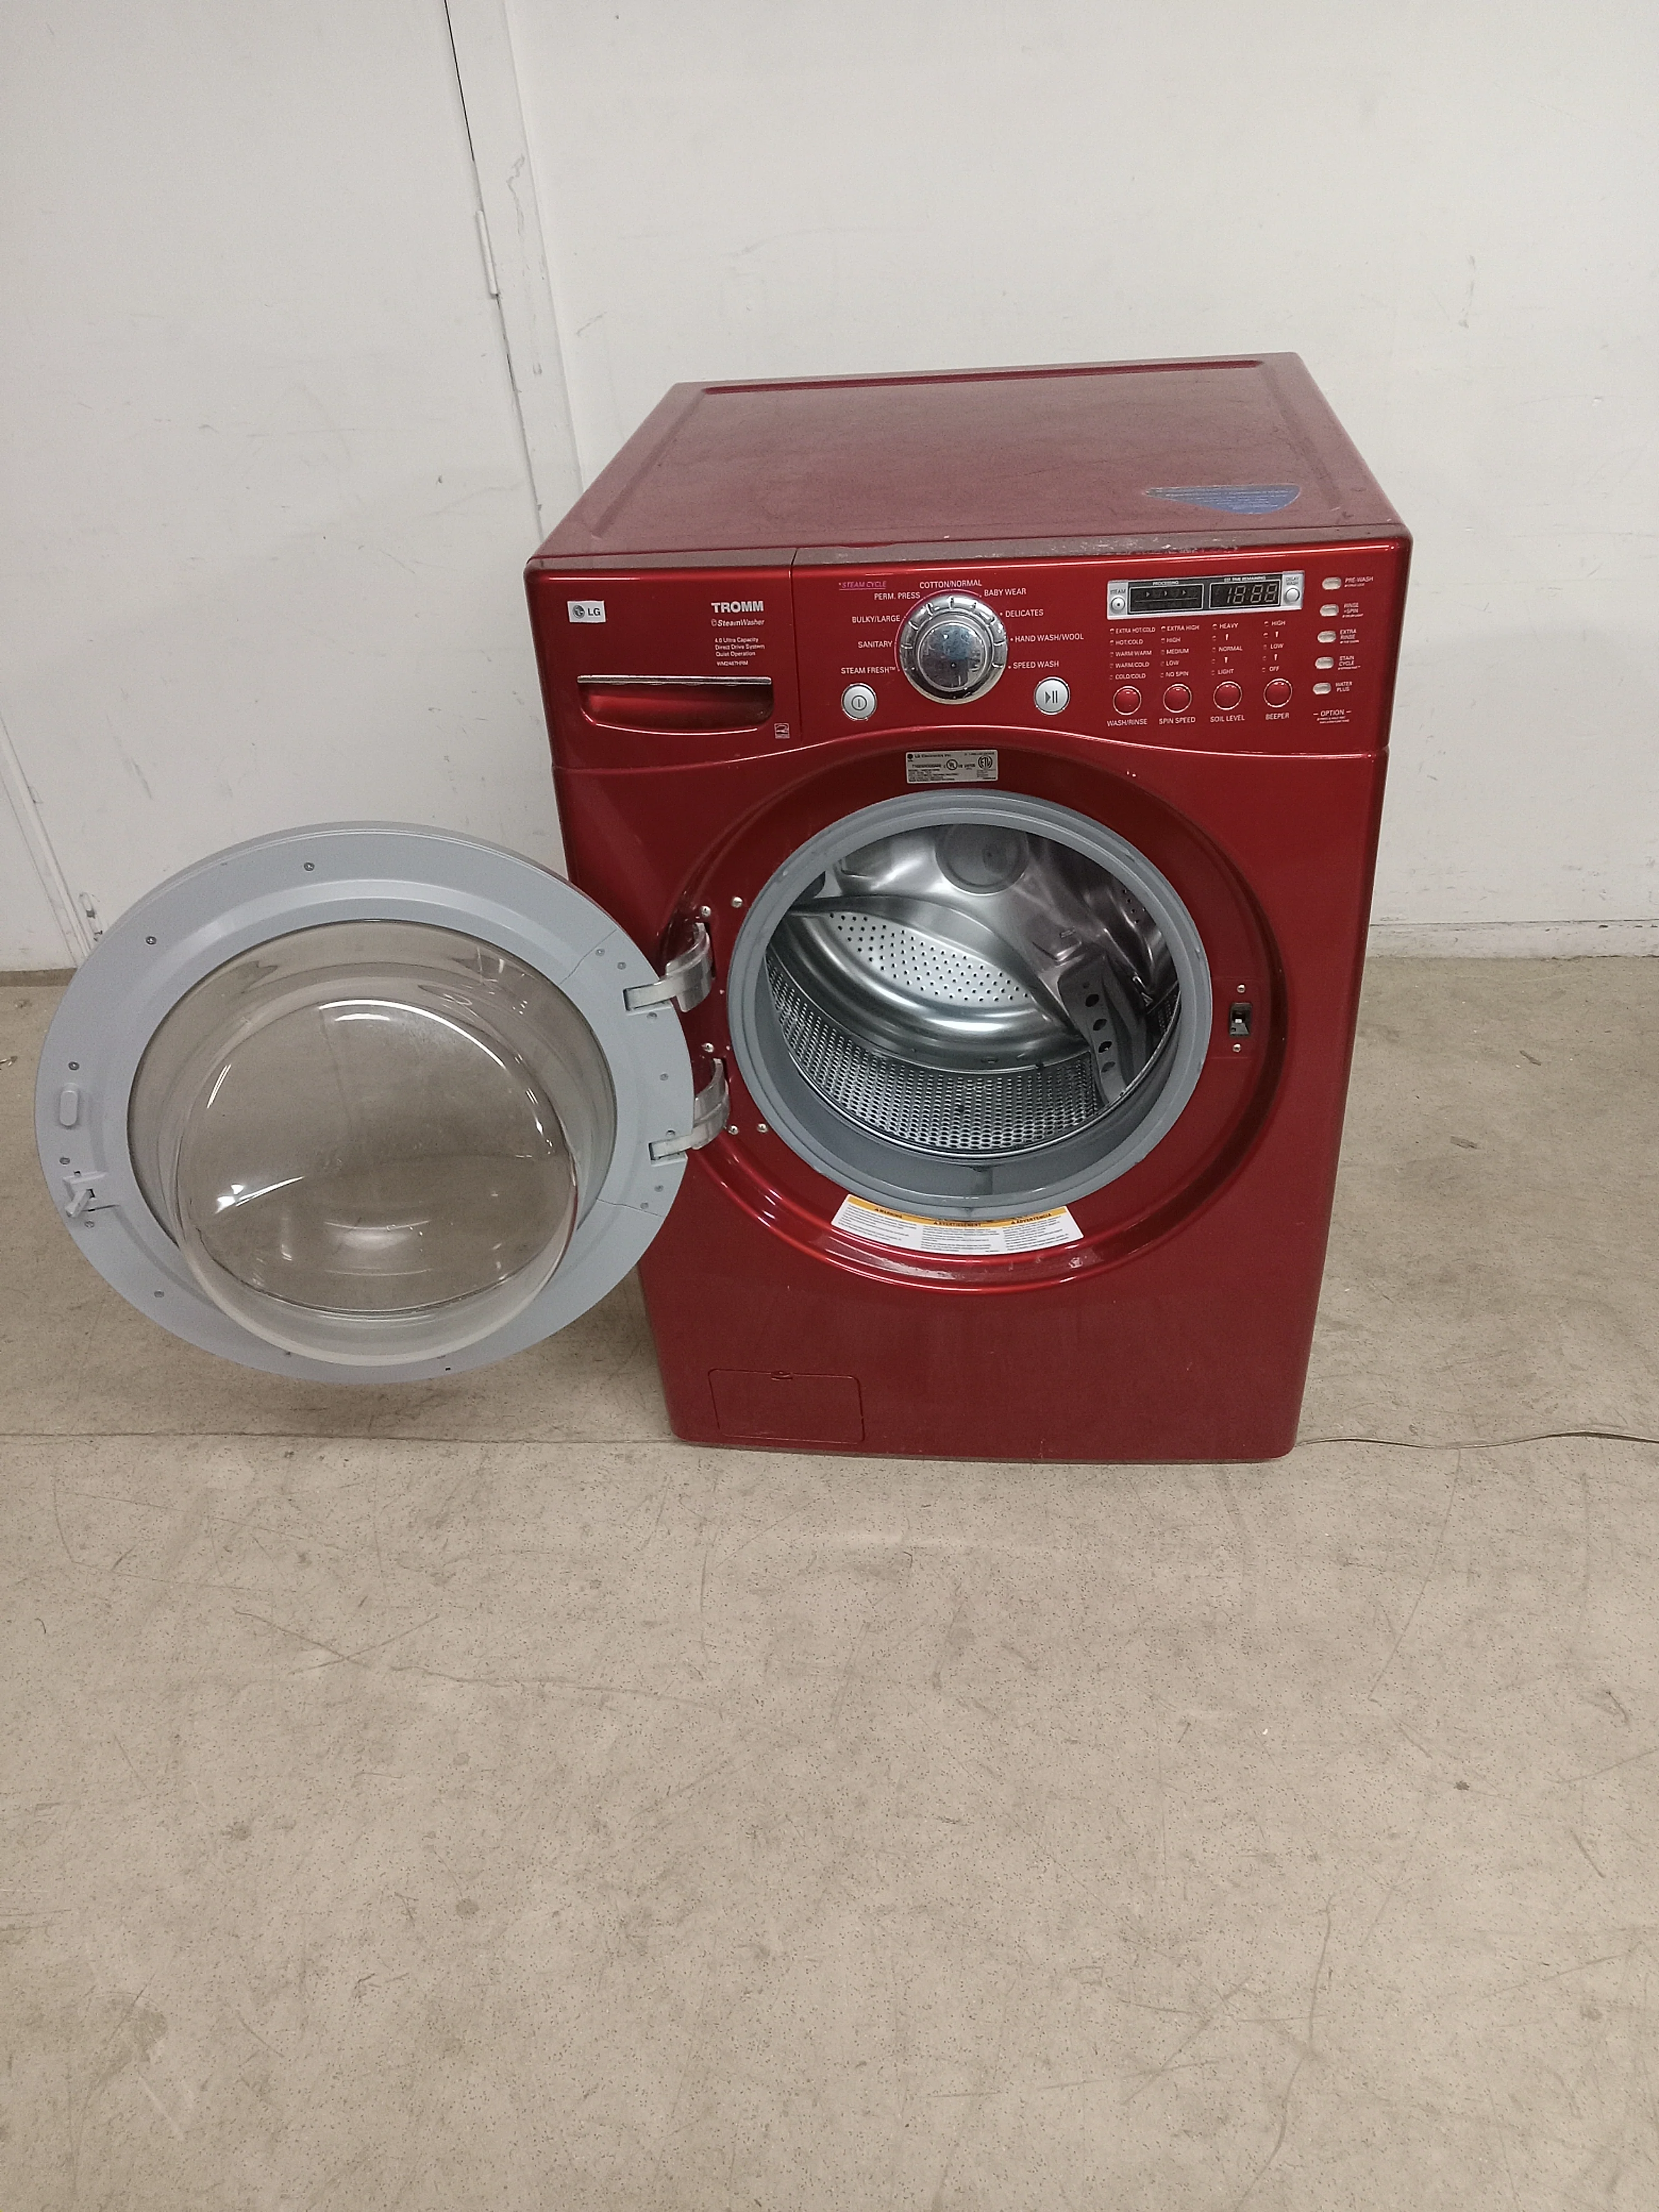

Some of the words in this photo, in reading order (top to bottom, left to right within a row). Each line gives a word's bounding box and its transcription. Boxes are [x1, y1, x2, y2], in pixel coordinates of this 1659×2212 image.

[919, 579, 982, 589] COTTON/NORMAL
[711, 601, 764, 613] TROMM
[588, 608, 601, 616] LG
[1006, 609, 1044, 617] DELICATES
[1036, 633, 1084, 642] WASH/WOOL
[1265, 712, 1290, 720] BEEPER
[1107, 718, 1148, 727] WASH/RINSE
[1159, 717, 1174, 725] SPIN
